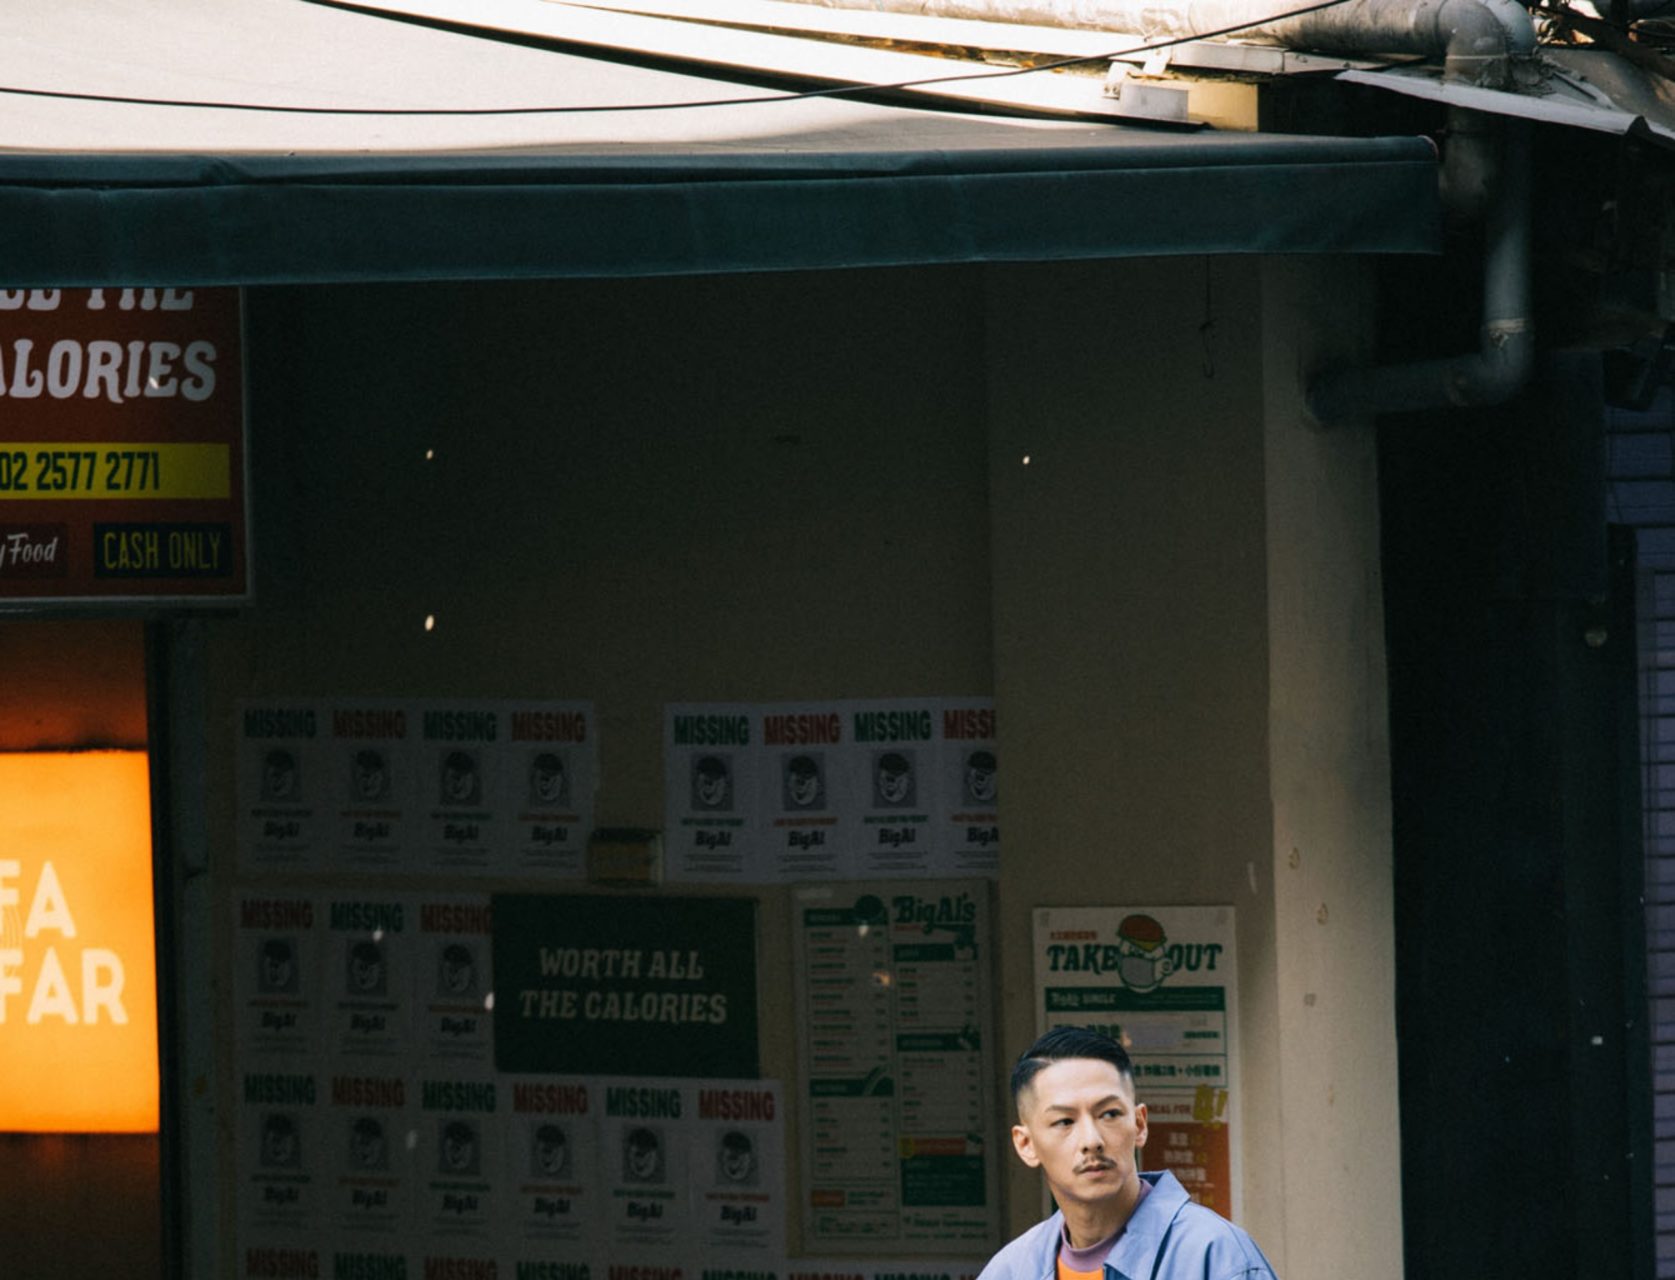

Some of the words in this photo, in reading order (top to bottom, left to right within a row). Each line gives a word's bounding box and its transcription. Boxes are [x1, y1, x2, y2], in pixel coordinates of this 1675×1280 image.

[0, 338, 217, 404] LORIES
[36, 451, 97, 491] 2577
[105, 451, 160, 491] 2771
[7, 532, 59, 565] Food
[103, 531, 158, 570] CASH
[168, 531, 222, 570] ONLY
[245, 709, 316, 739] MISSING
[333, 710, 406, 740] MISSING
[424, 711, 497, 742] MISSING
[511, 712, 585, 742] MISSING
[674, 715, 749, 745] MISSING
[765, 714, 840, 745] MISSING
[855, 710, 931, 742] MISSING
[330, 902, 404, 933] MISSING
[539, 946, 641, 980] WORTH
[647, 949, 704, 981] ALL
[1046, 944, 1120, 975] TAKE
[1166, 943, 1223, 972] OUT
[0, 946, 129, 1025] FAR
[520, 988, 577, 1020] THE
[584, 991, 728, 1026] CALORIES
[245, 1074, 316, 1106] MISSING
[332, 1075, 405, 1108] MISSING
[422, 1080, 496, 1112] MISSING
[513, 1082, 588, 1115] MISSING
[606, 1086, 682, 1119] MISSING
[699, 1089, 774, 1122] MISSING
[247, 1249, 319, 1280] MISSING
